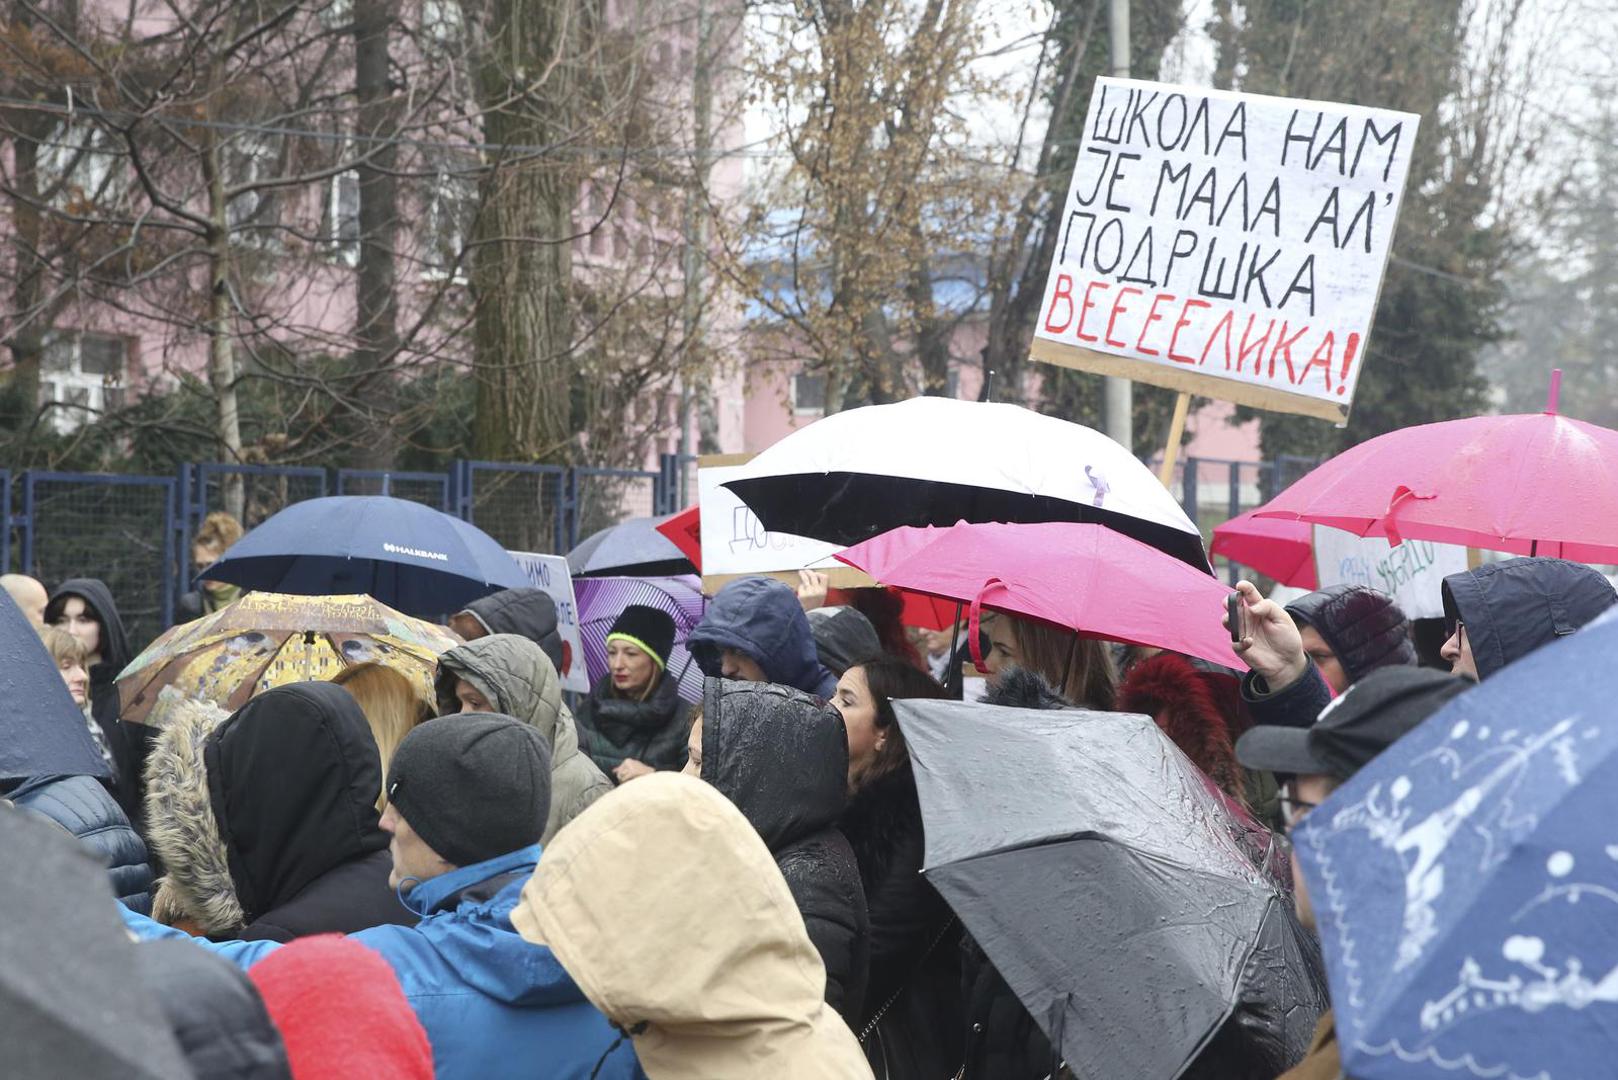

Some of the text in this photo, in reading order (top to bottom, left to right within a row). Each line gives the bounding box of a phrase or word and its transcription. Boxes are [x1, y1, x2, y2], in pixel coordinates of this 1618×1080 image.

[1092, 84, 1403, 182] ШКОЛА НАМ
[1076, 146, 1142, 213] ЈЕ
[1149, 159, 1280, 237] МАЛА
[1060, 210, 1316, 317] ПОДРШКА
[1044, 273, 1361, 396] ВЕЕЕЕЛИКА!
[396, 546, 449, 561] HALKBANK
